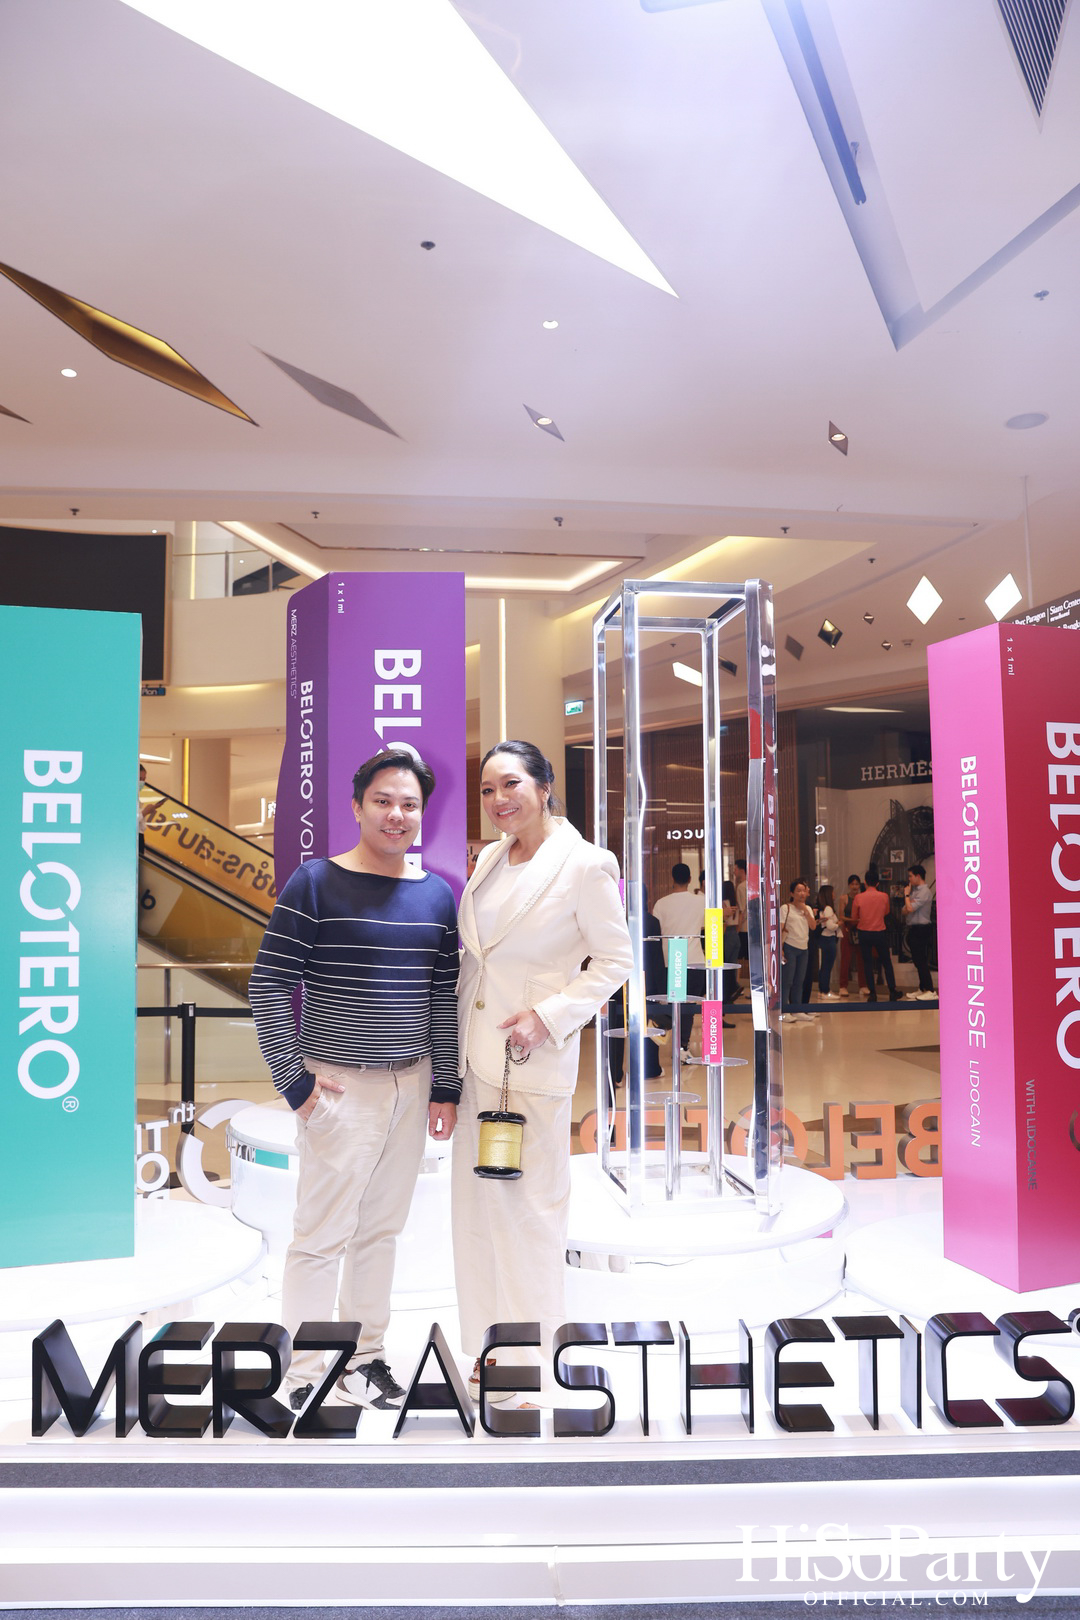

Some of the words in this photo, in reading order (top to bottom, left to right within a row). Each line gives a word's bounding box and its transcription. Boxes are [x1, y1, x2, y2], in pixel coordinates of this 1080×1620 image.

[674, 951, 683, 988] BELOTERO
[965, 911, 986, 1048] INTENSE
[969, 1060, 981, 1147] LIDOCAIN
[1026, 1079, 1035, 1114] WITH
[1026, 1118, 1037, 1190] LIDOCAINE
[32, 1319, 362, 1439] MERZ
